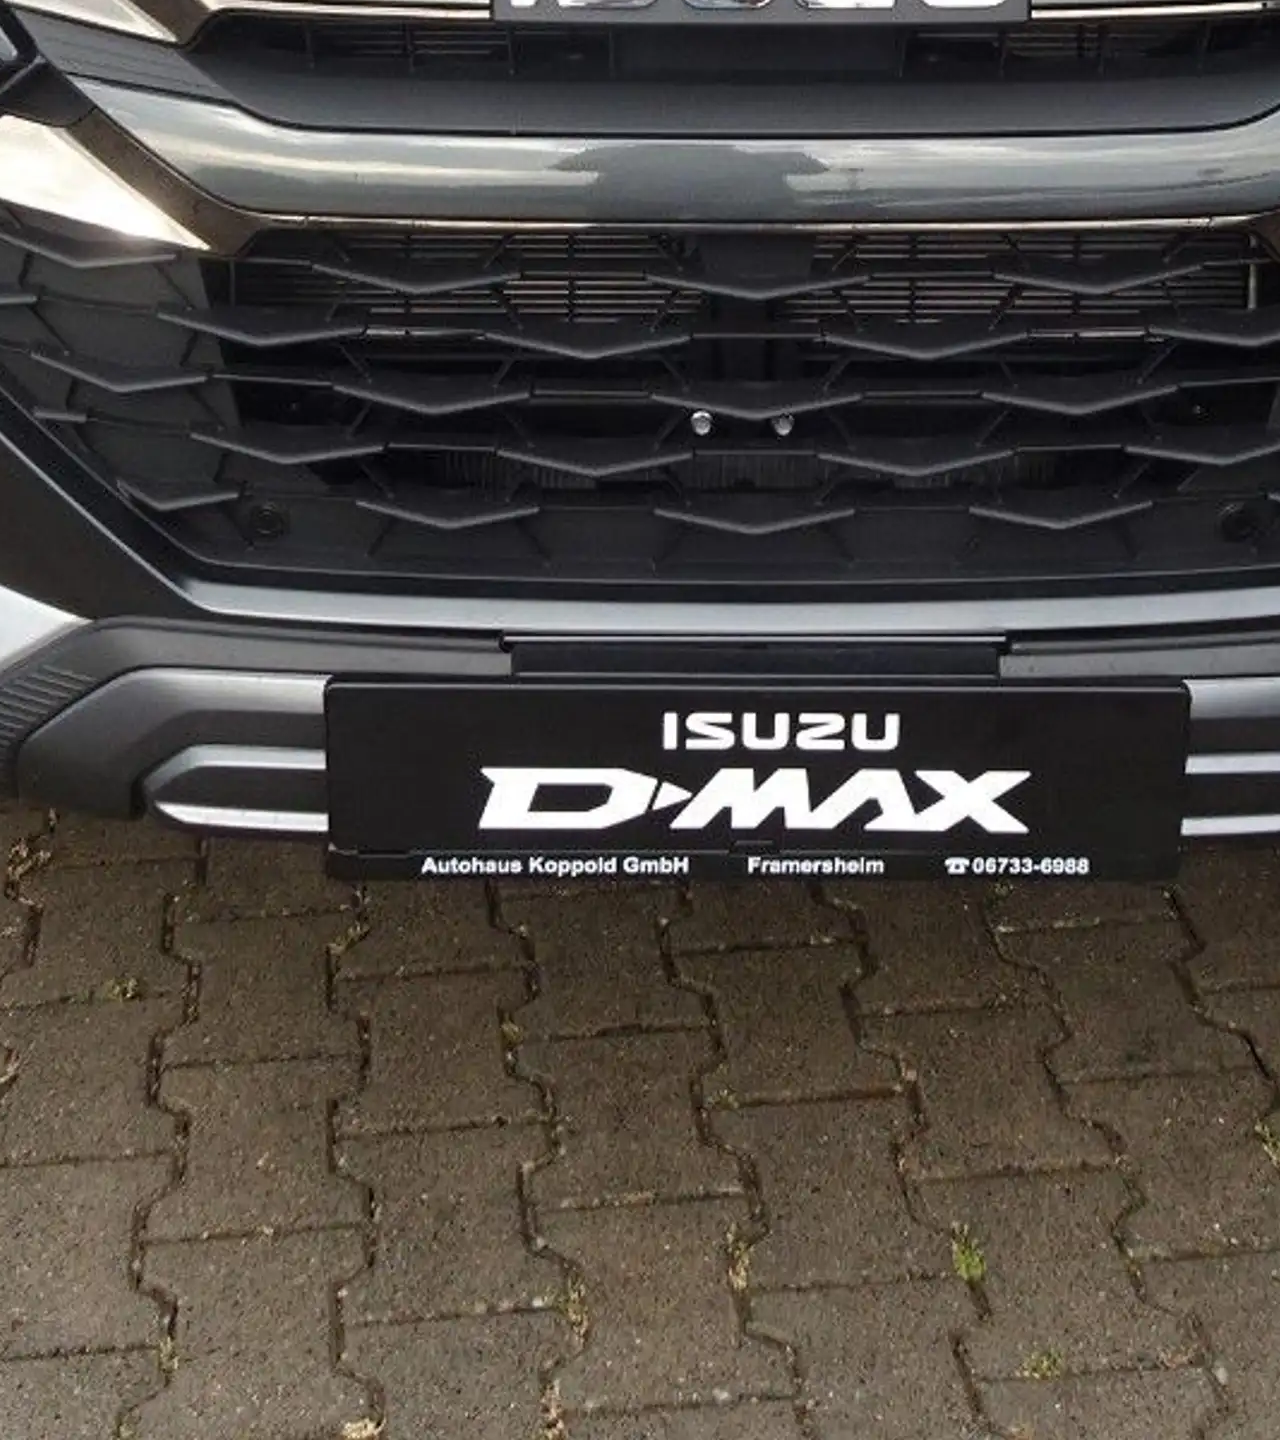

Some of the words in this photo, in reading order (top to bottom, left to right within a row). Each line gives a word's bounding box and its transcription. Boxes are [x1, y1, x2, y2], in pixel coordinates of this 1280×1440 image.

[662, 711, 900, 751] ISUZU
[478, 767, 1031, 834] D-MAX
[421, 856, 523, 874] Autohaus
[528, 856, 617, 878] Koppold
[622, 856, 690, 874] GmbH
[747, 856, 885, 874] Framersheim
[972, 857, 1090, 875] 06733-6988
